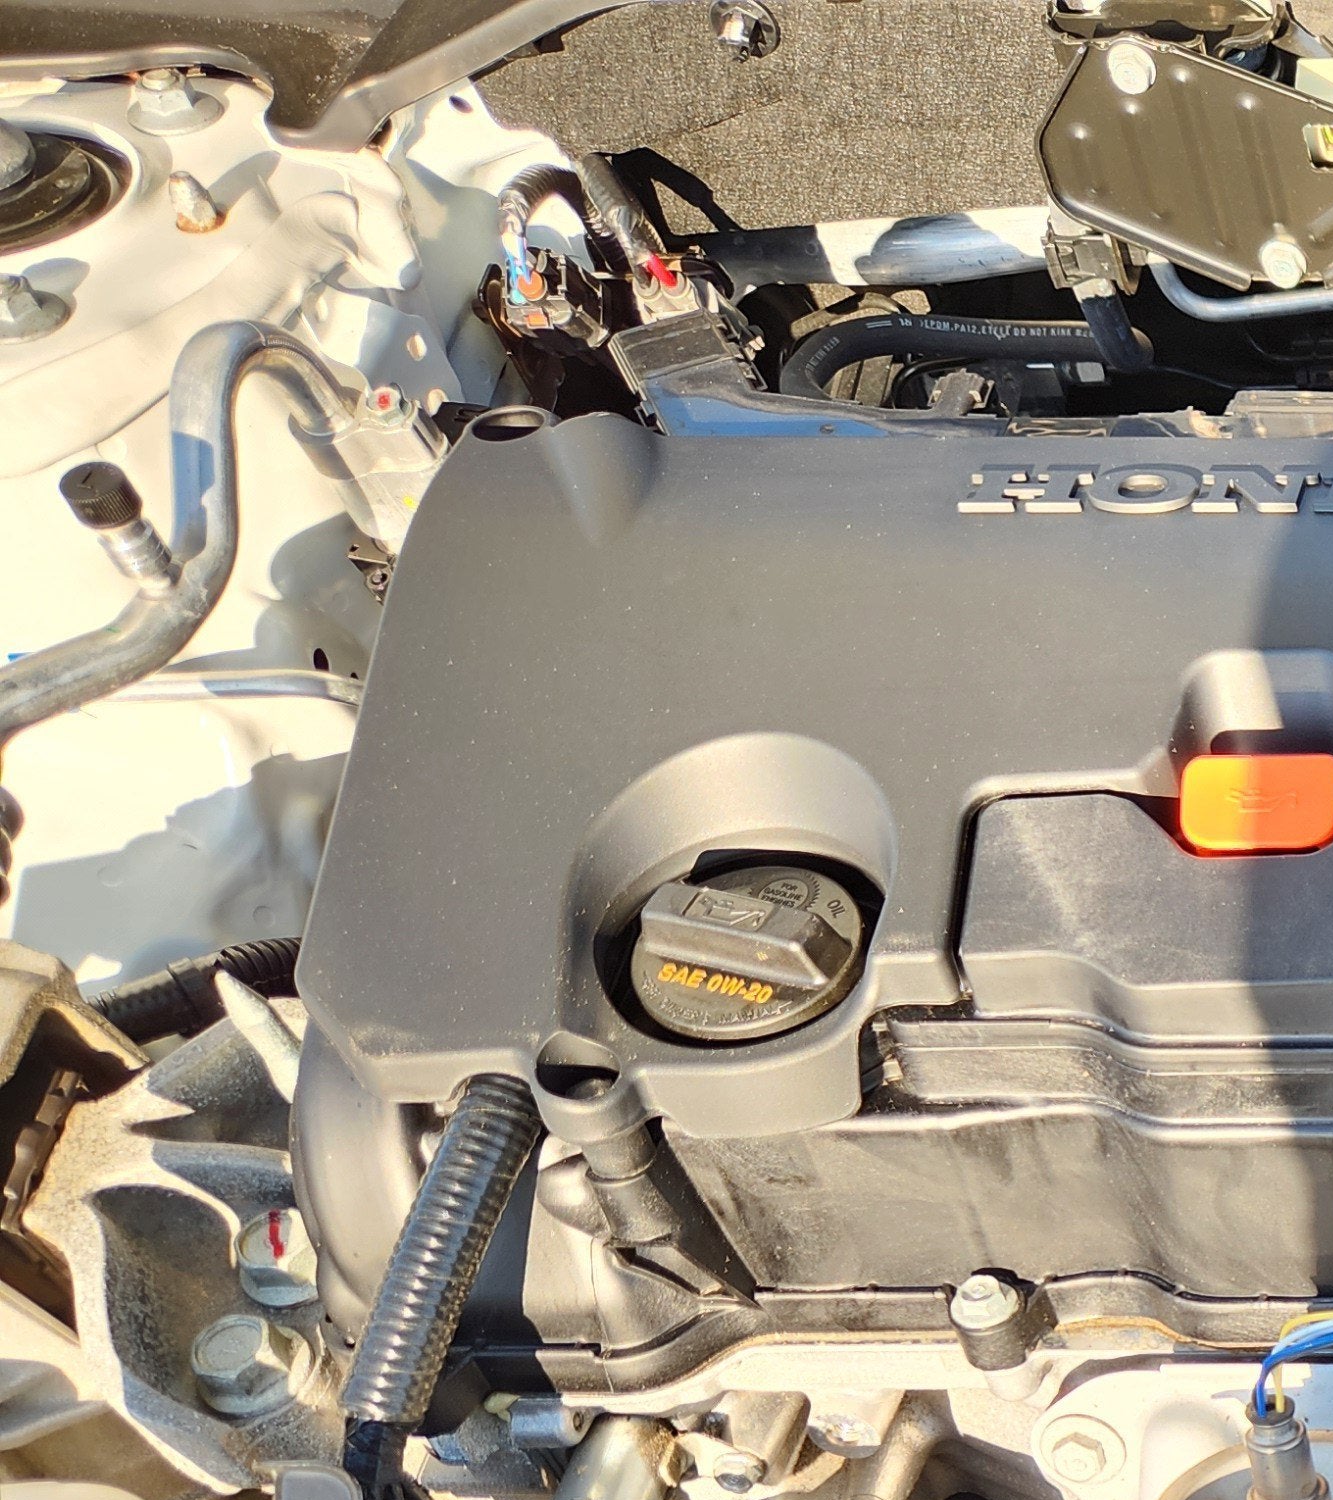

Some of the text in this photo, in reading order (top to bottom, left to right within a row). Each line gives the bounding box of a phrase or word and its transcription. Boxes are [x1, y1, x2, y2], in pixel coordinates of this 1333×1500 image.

[1030, 328, 1047, 337] NOT
[764, 887, 804, 901] GASOLINE
[781, 882, 798, 892] FOR
[827, 899, 846, 919] OIL
[658, 963, 707, 989] SAE
[706, 973, 773, 1005] 0W-20
